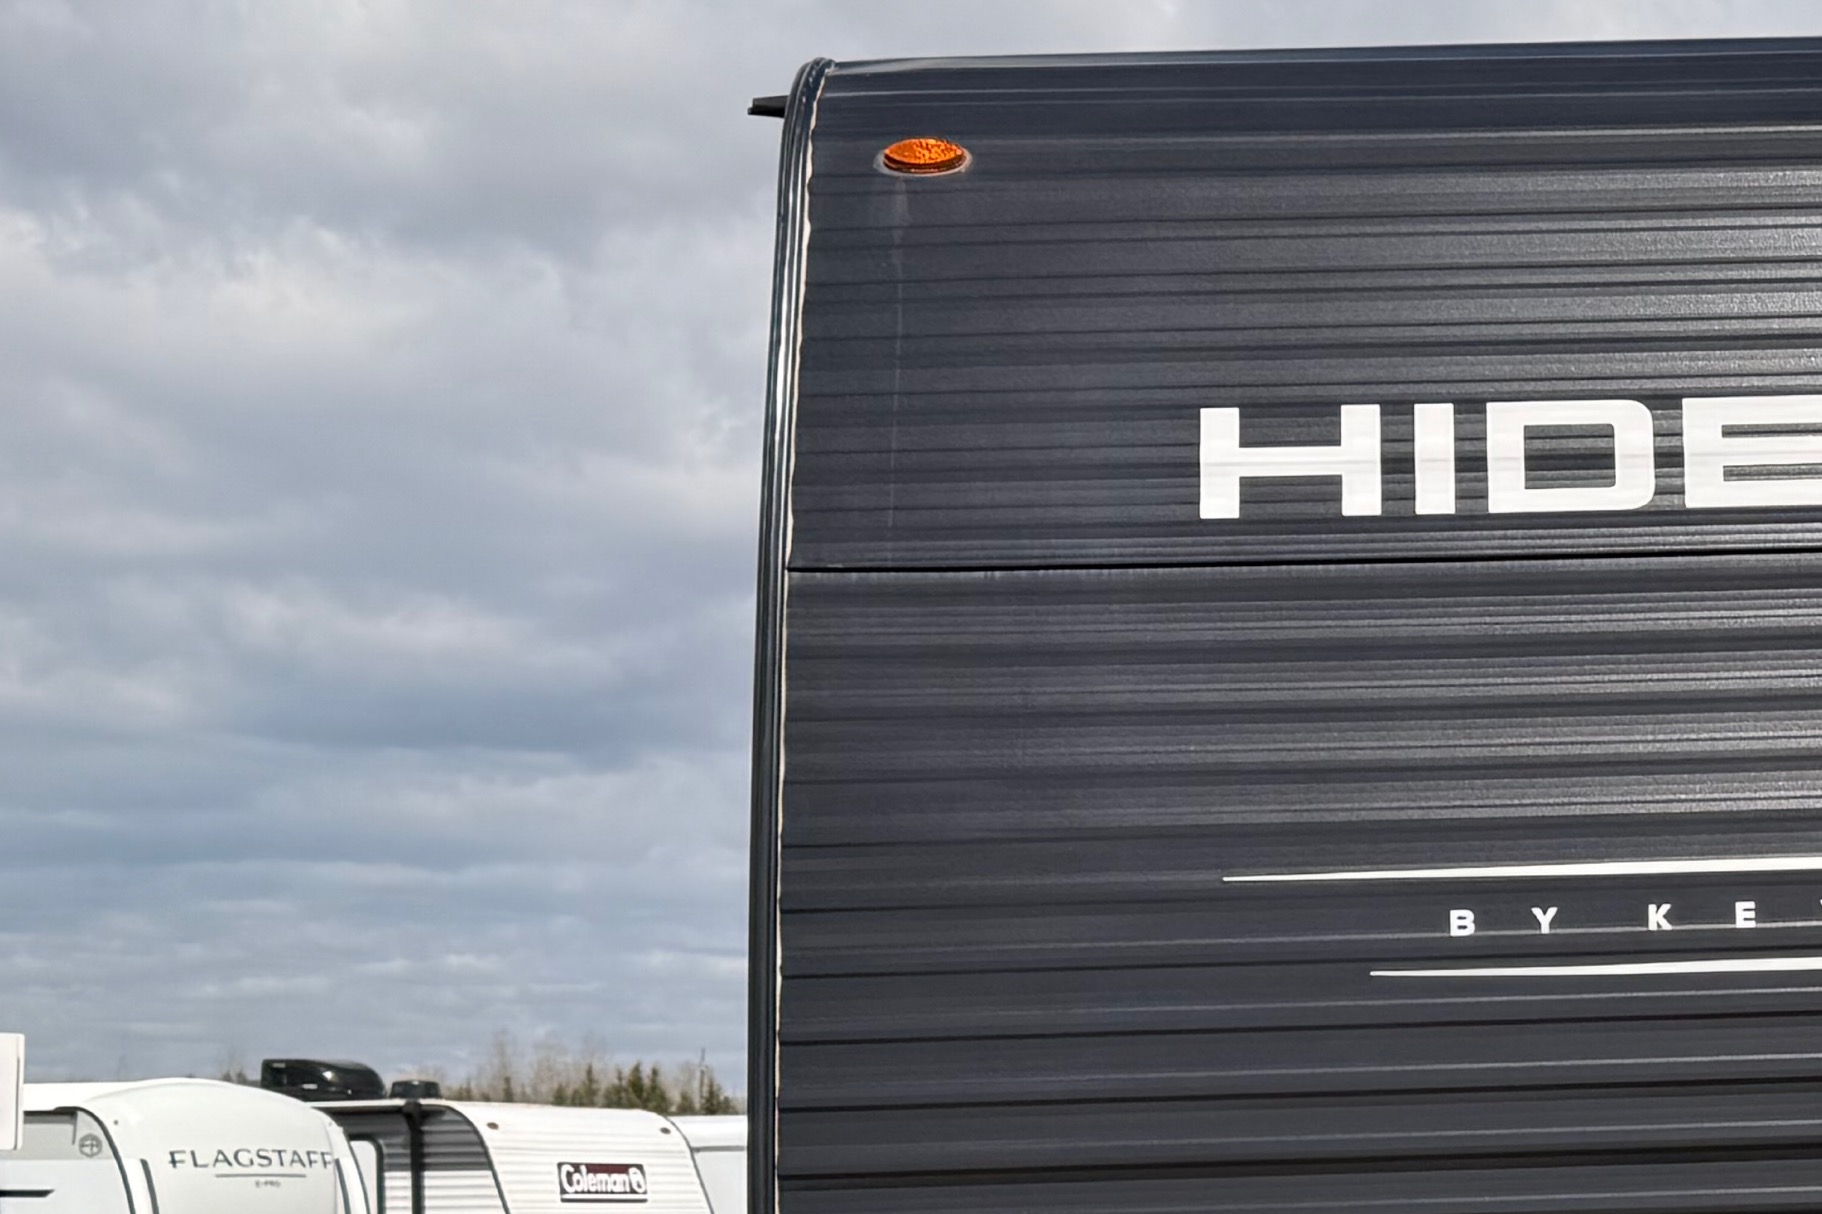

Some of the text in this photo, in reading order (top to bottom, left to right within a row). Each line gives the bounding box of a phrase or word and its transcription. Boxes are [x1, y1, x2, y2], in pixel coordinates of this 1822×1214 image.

[1449, 906, 1558, 937] BY
[168, 1148, 333, 1170] FLAGSTAFF
[560, 1164, 631, 1194] Coleman
